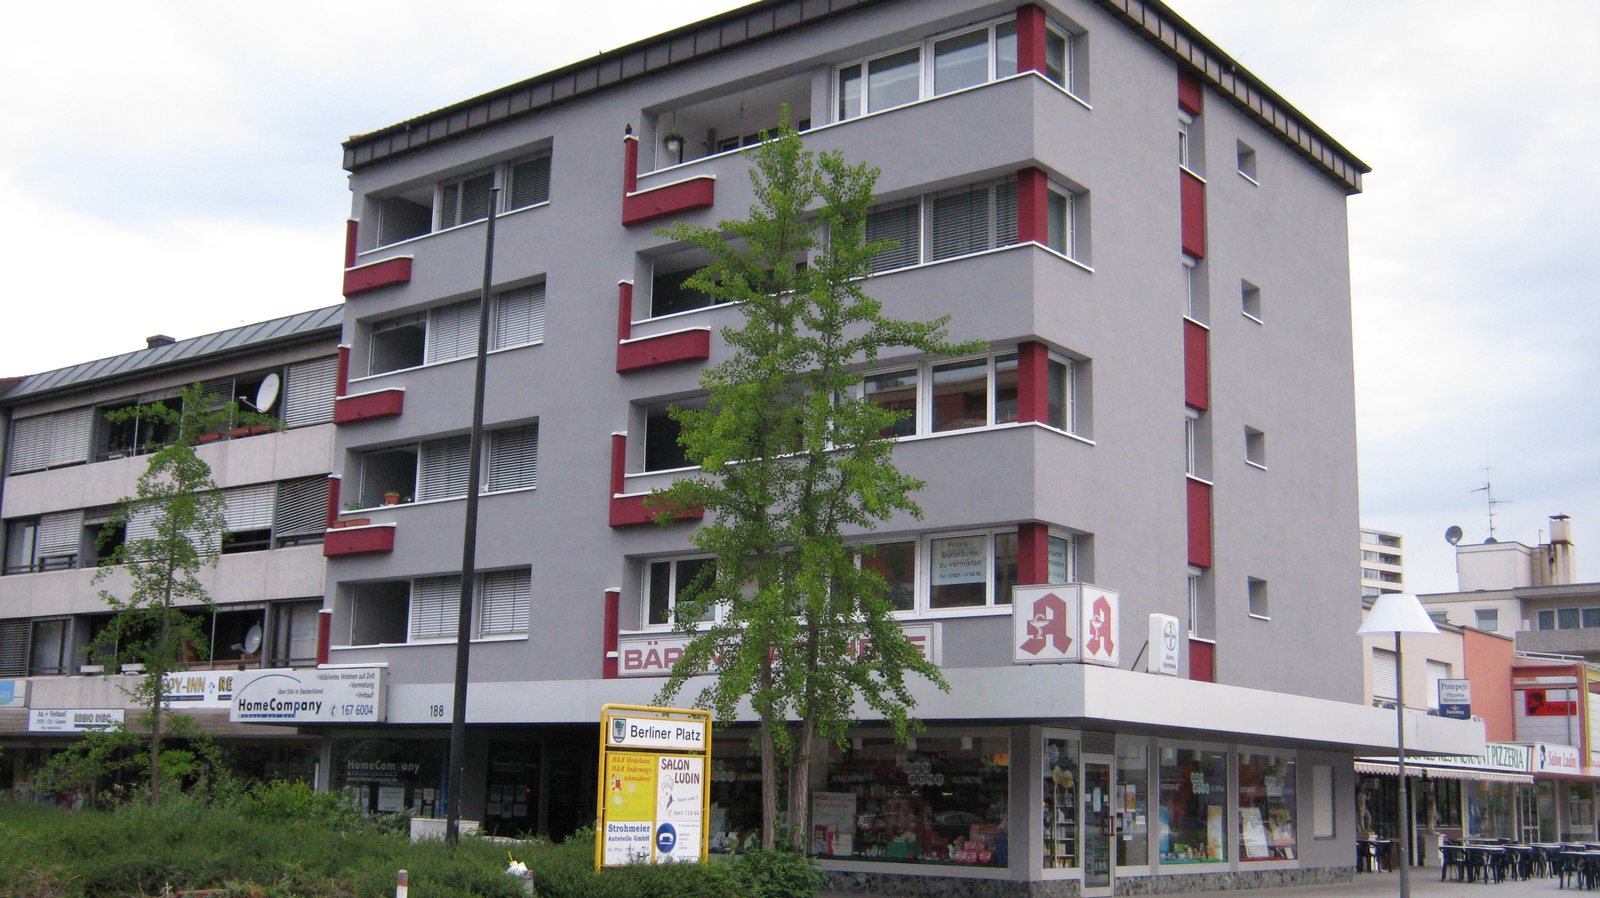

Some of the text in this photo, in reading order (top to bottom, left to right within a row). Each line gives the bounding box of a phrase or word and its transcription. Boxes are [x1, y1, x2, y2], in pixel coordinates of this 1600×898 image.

[949, 559, 982, 568] vermieten
[366, 672, 375, 680] Zeit
[357, 691, 374, 699] Verkauf
[238, 698, 322, 715] HomeCompany
[341, 704, 373, 716] 167 6004
[430, 704, 444, 718] 188
[631, 725, 701, 741] Berliner Platz
[1492, 745, 1524, 769] PIZZERIA
[347, 760, 420, 774] HomeComany
[661, 758, 690, 771] SALON
[674, 772, 700, 784] LUDIN
[608, 824, 650, 833] Strohmeier
